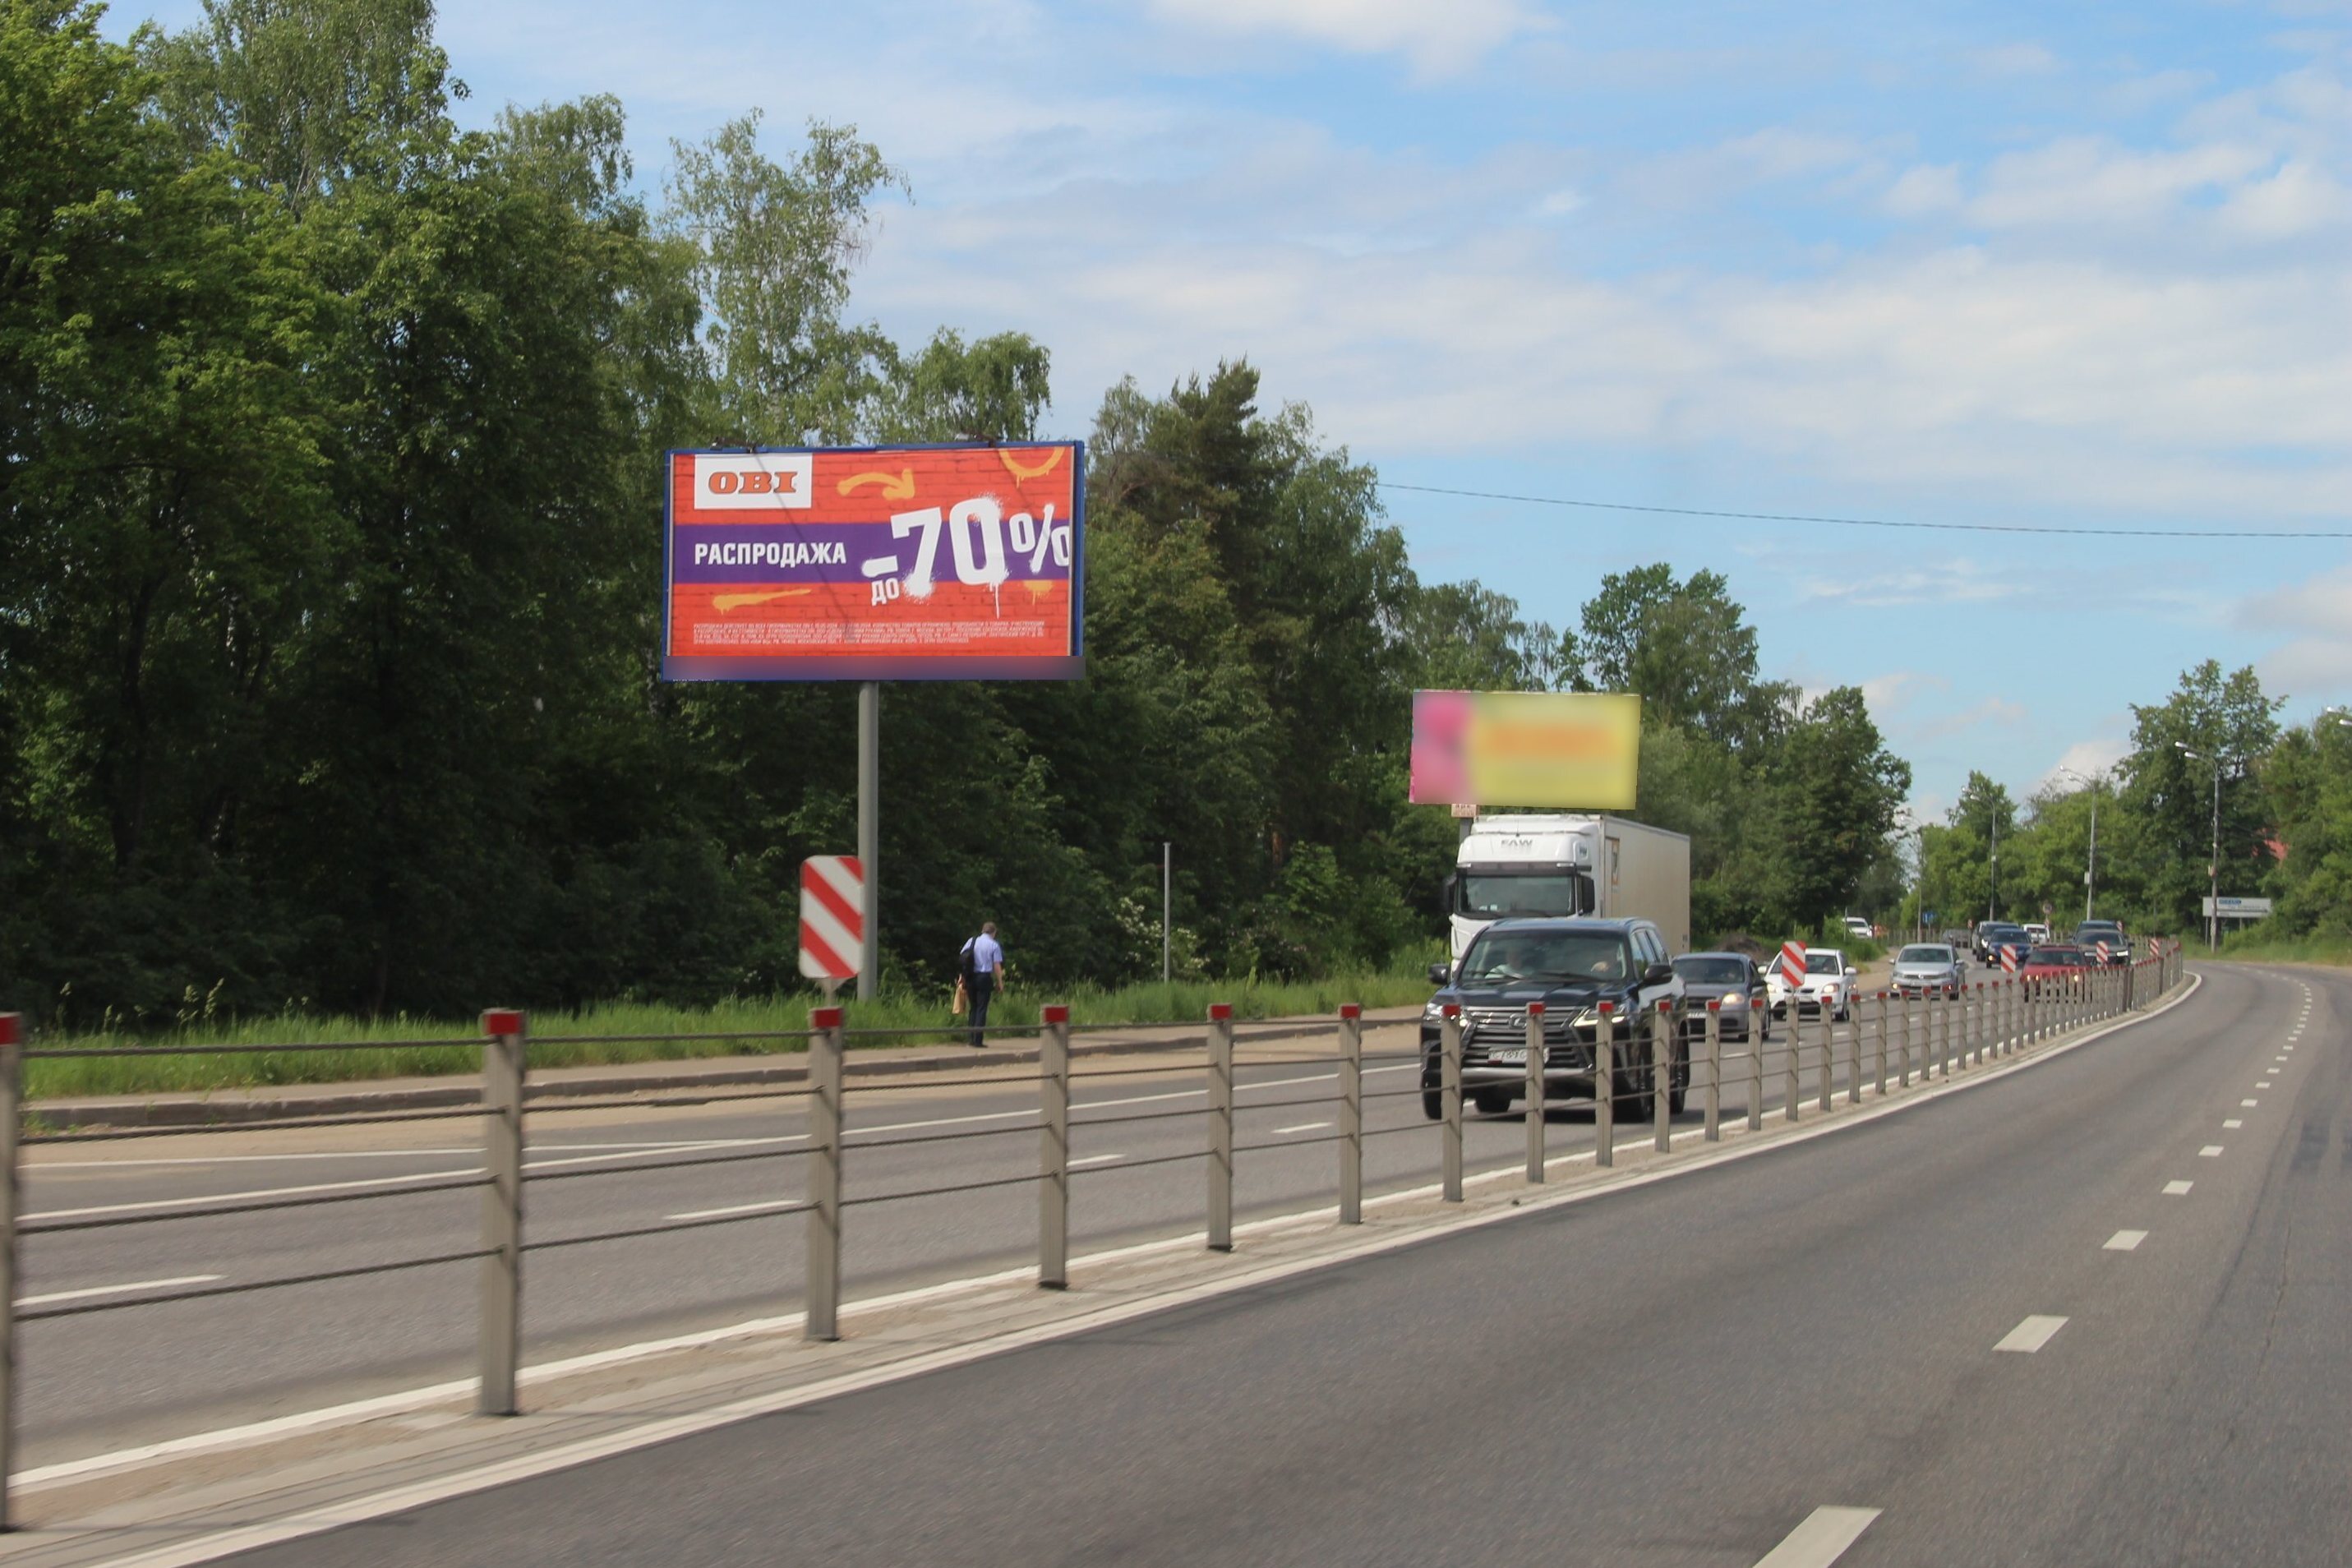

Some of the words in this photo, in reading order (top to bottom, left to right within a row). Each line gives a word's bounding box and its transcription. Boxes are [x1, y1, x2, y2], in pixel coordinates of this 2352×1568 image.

[708, 471, 798, 494] OBI
[694, 542, 846, 569] РАСПРОДАЖА
[860, 495, 1071, 600] -70%
[1501, 839, 1533, 847] FAW
